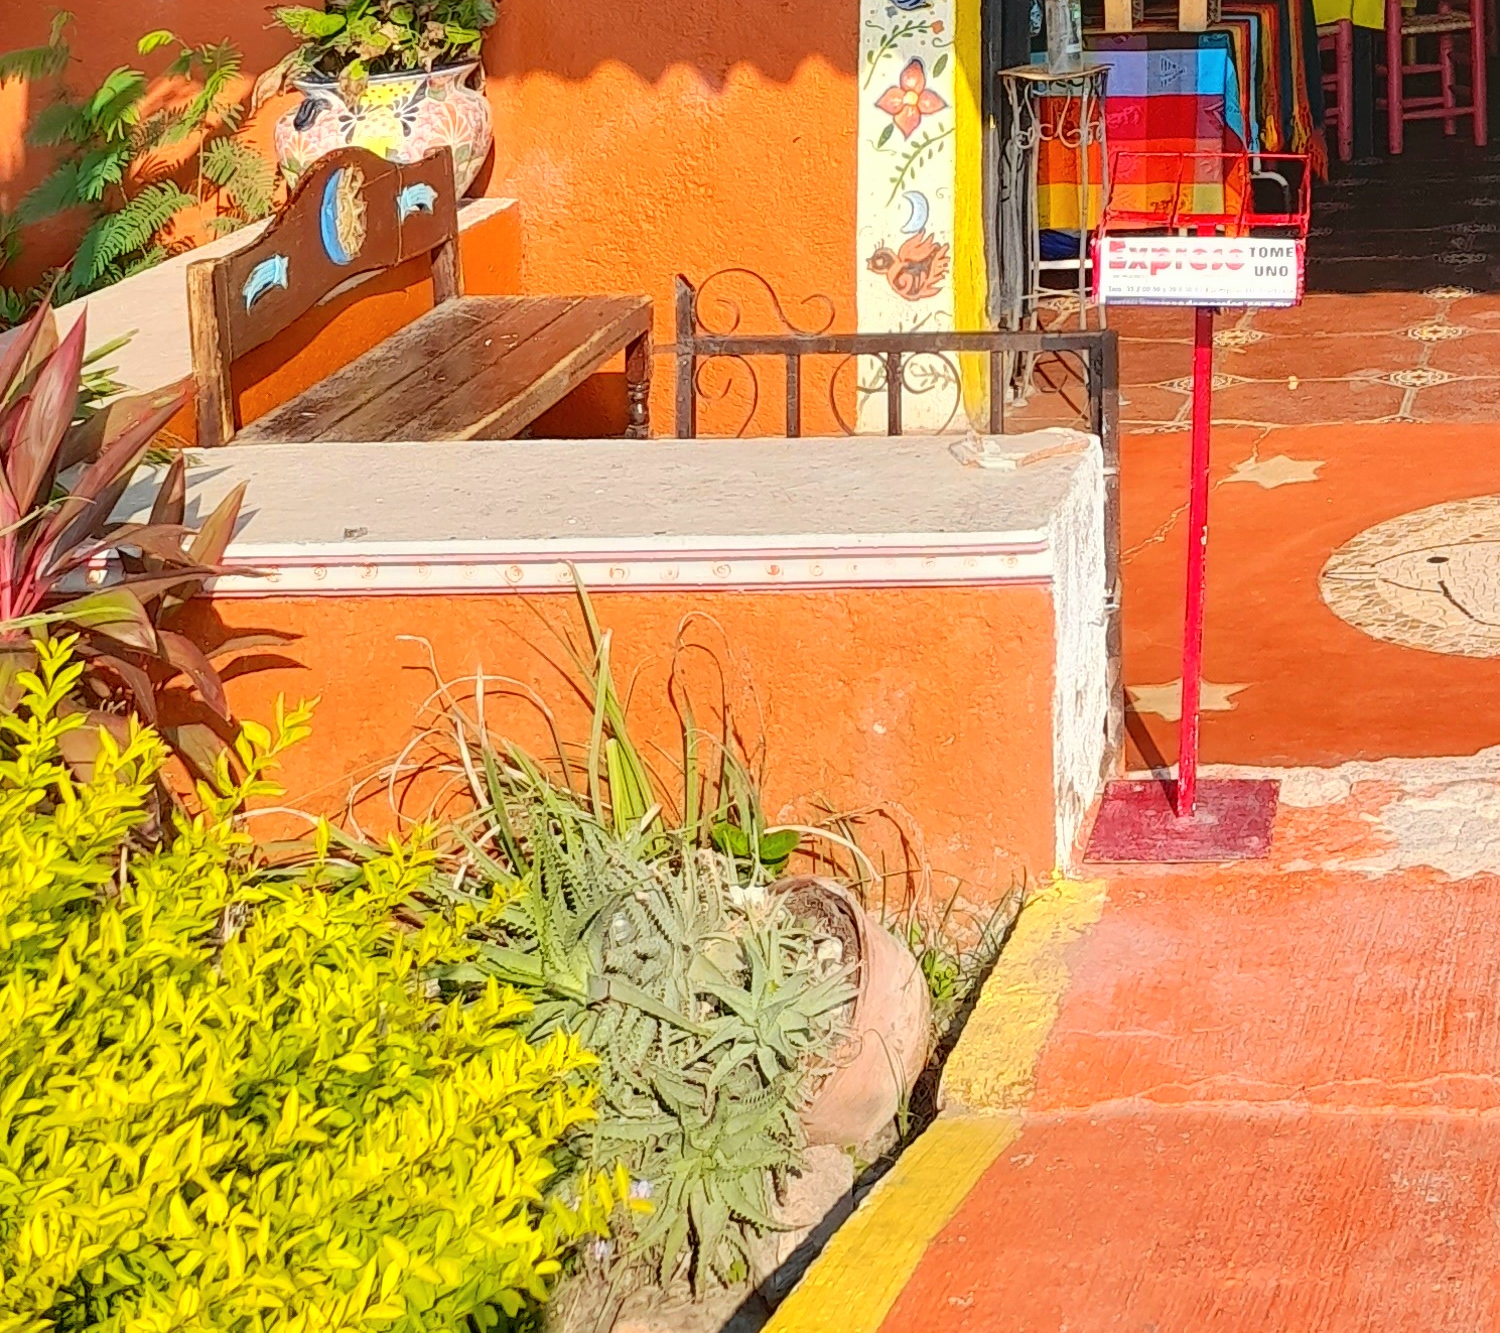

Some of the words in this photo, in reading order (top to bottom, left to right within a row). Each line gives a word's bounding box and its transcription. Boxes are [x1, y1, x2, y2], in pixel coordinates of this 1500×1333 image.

[1108, 240, 1245, 276] Expreso
[1249, 246, 1294, 258] TOME
[1254, 265, 1289, 277] UNO
